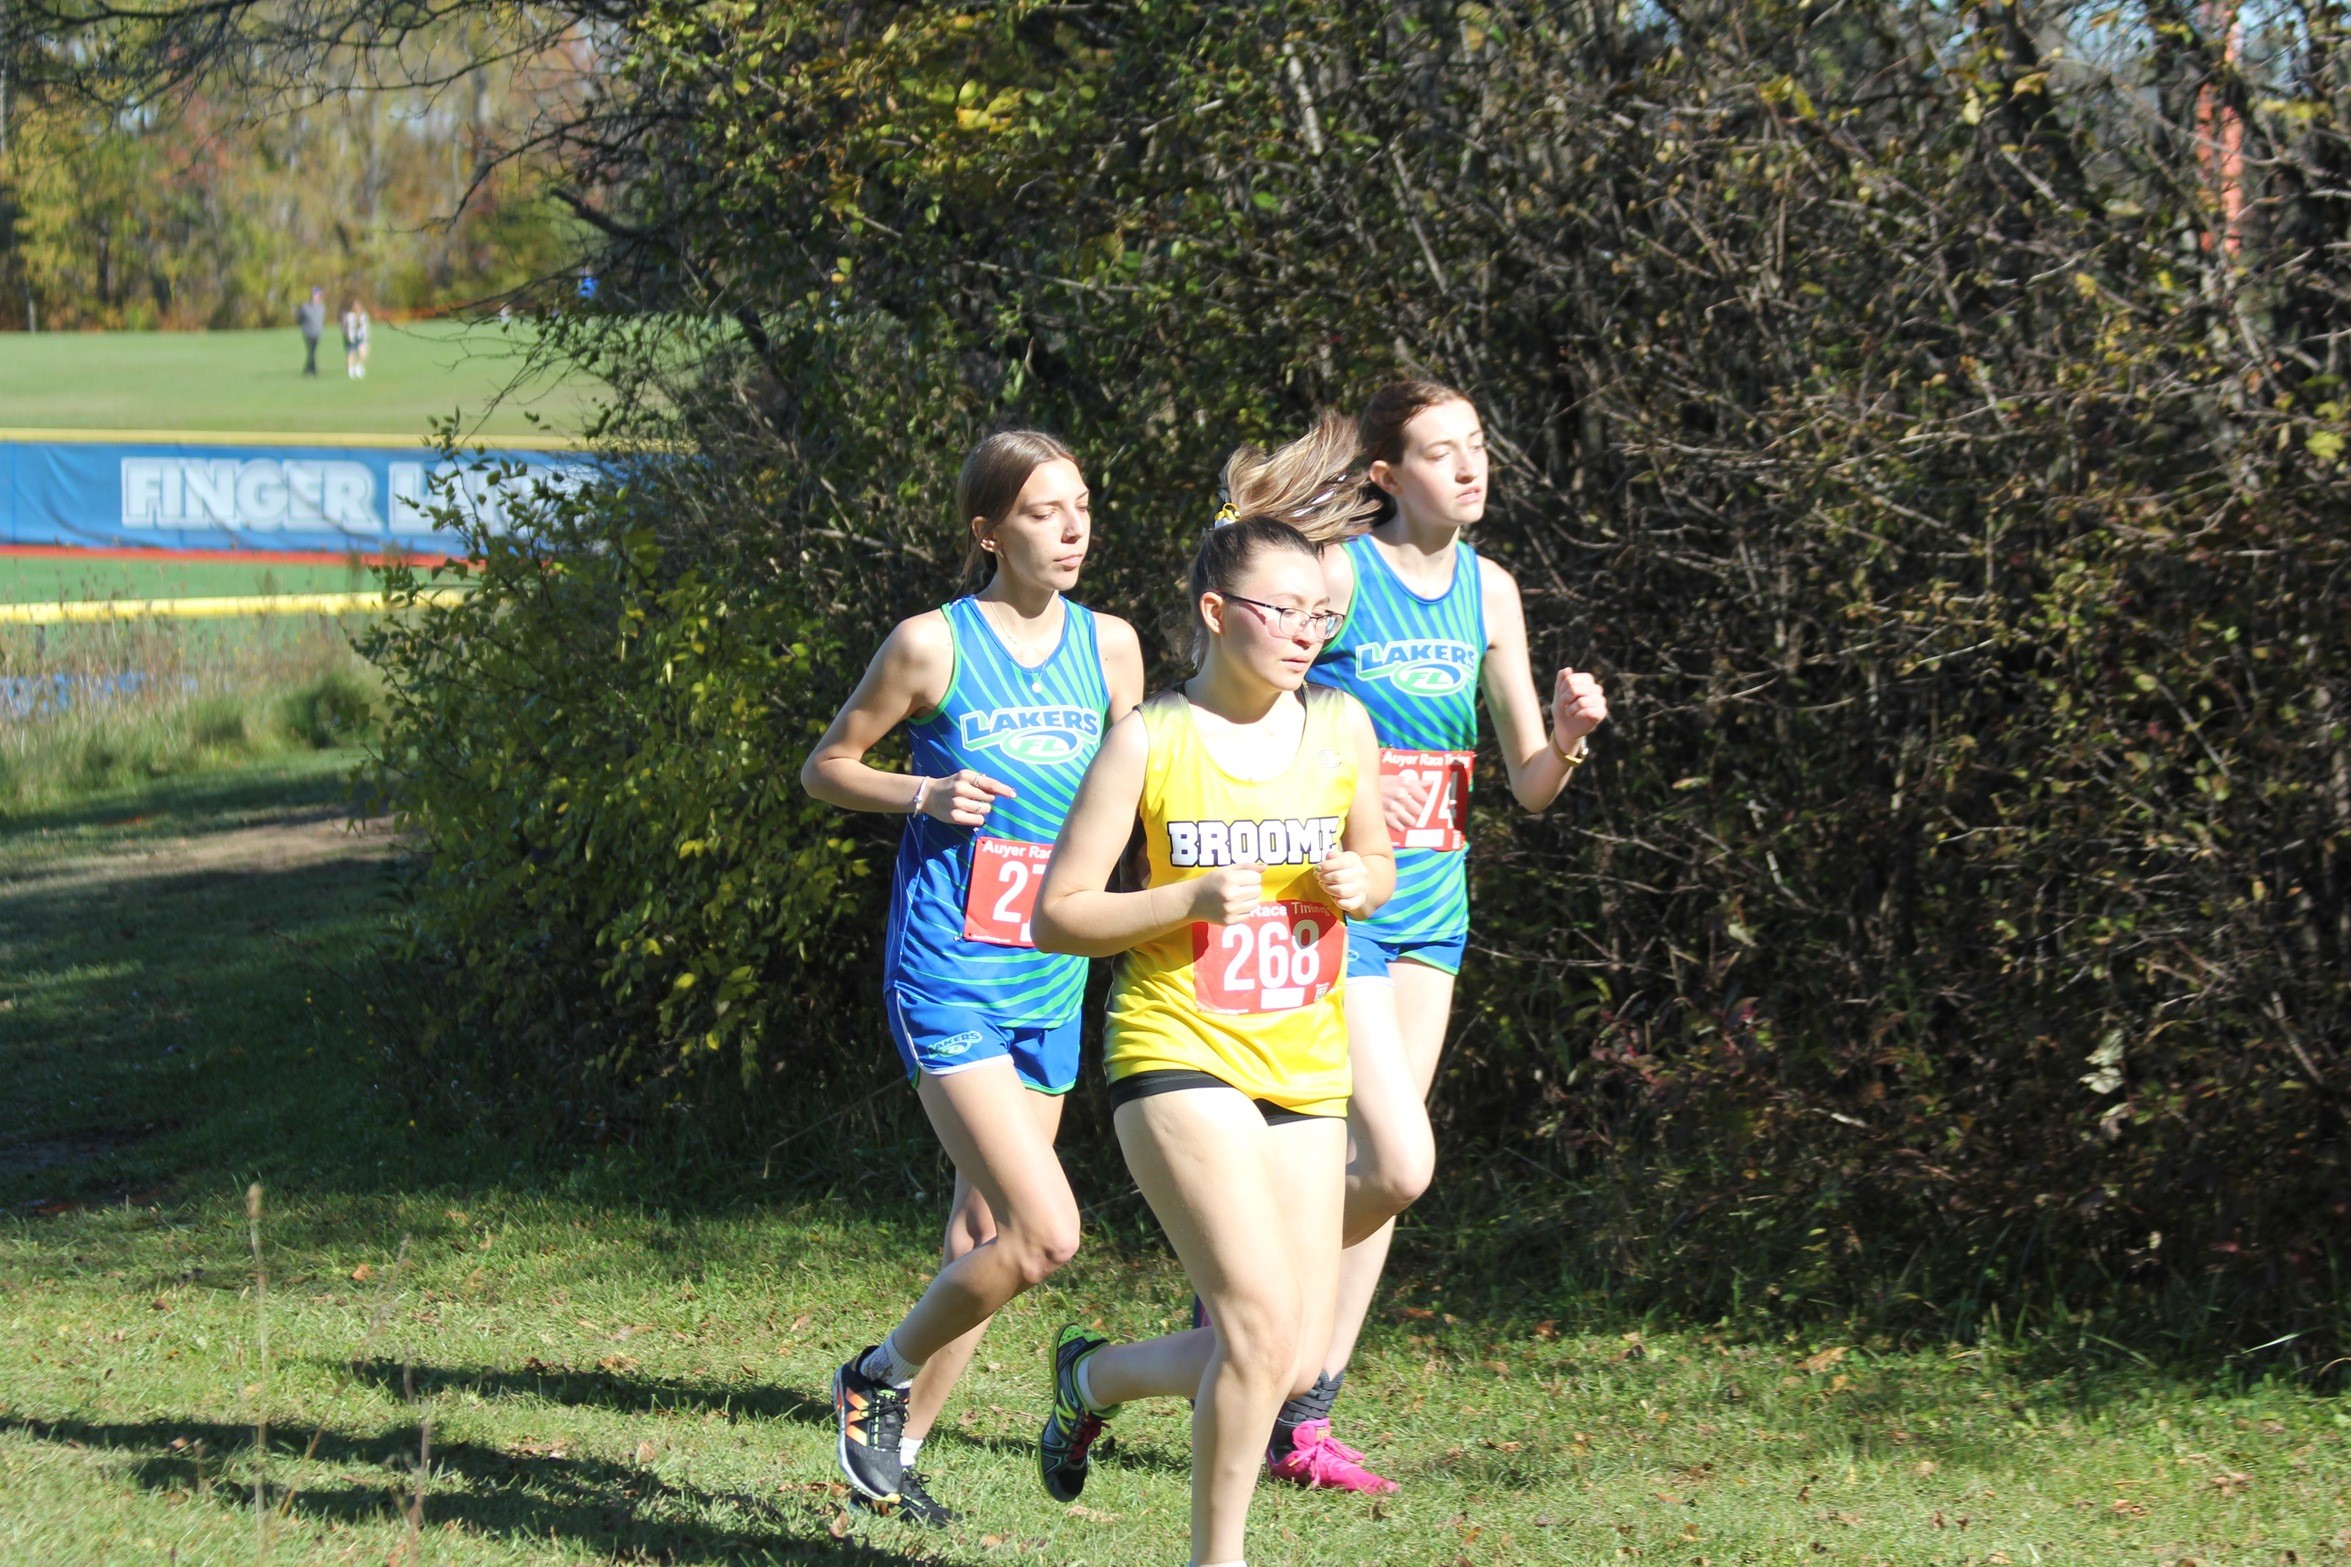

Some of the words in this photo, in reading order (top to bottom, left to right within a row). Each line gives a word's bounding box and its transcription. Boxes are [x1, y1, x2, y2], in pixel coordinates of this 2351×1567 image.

[121, 456, 381, 533] FINGER
[1356, 640, 1479, 678] LAKERS
[961, 707, 1100, 747] LAKERS
[1382, 751, 1419, 767] Auyer
[1419, 753, 1444, 766] Race
[1397, 768, 1458, 829] 74
[982, 840, 1026, 857] Auyer
[1029, 845, 1052, 859] Rac
[1167, 816, 1340, 867] BROOME
[1222, 920, 1320, 991] 268
